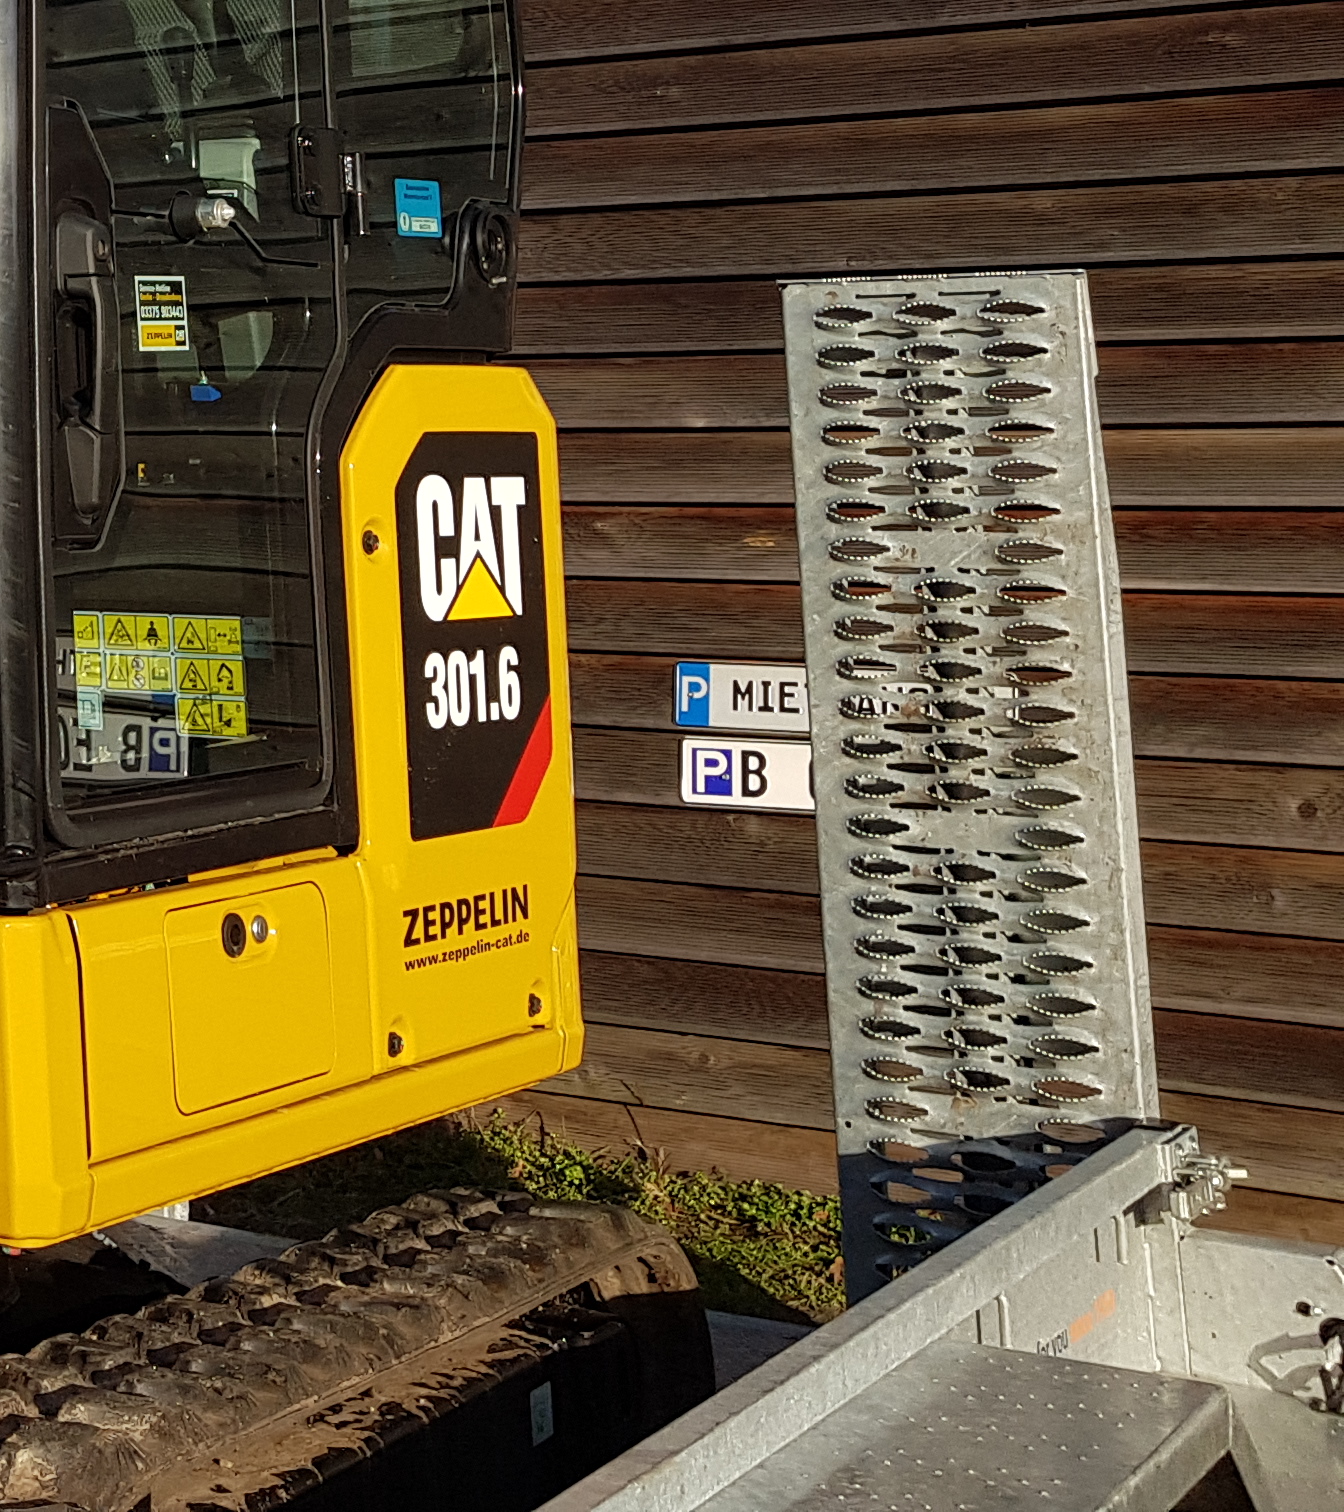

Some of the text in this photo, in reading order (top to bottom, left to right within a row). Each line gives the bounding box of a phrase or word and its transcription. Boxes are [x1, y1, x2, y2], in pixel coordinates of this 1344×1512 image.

[416, 473, 526, 622] CAT
[423, 645, 521, 730] 301.6
[681, 675, 708, 713] P
[732, 679, 809, 714] MIE
[696, 749, 728, 794] P
[740, 749, 768, 798] B
[402, 883, 530, 949] ZEPPELIN
[403, 929, 531, 972] www.zeppelin-cat.de
